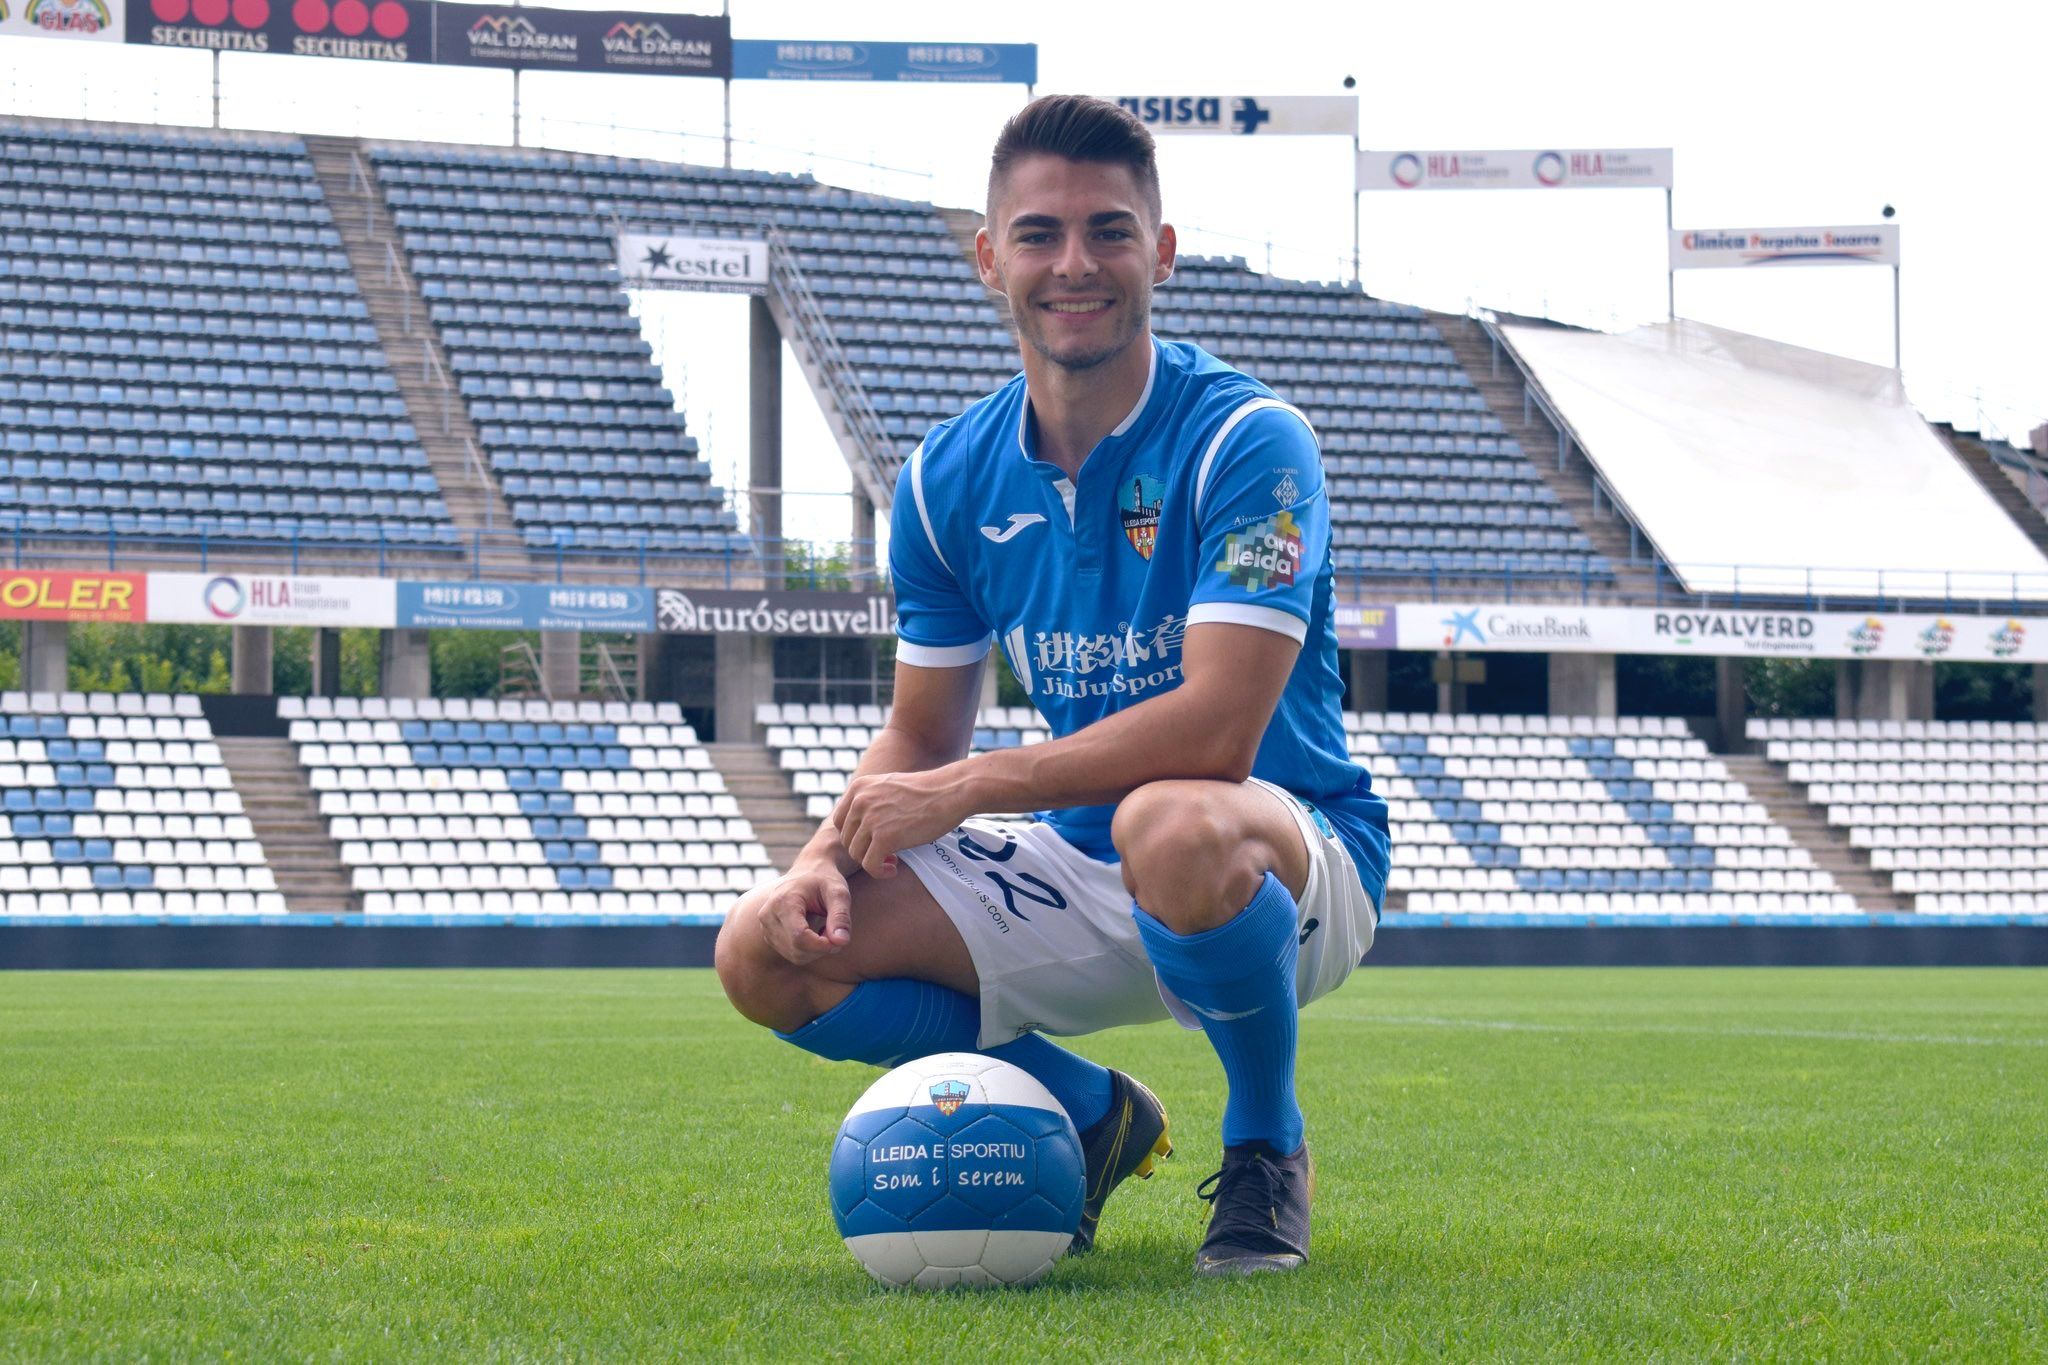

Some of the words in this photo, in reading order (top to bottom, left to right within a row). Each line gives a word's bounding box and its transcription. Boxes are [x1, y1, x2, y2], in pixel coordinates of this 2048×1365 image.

[151, 25, 269, 52] SECURITAS
[293, 35, 408, 61] SECURITAS
[467, 30, 504, 46] VAL
[602, 37, 639, 53] VAL
[1428, 155, 1460, 177] HLA
[1571, 154, 1604, 176] HLA
[675, 254, 751, 278] estel
[1264, 533, 1299, 558] ara
[1227, 543, 1292, 575] lleida
[0, 577, 134, 610] OLER
[251, 581, 291, 609] HLA
[1488, 615, 1590, 638] CaixaBank
[1655, 614, 1813, 638] ROYALVERD
[872, 1145, 928, 1163] LLEIDA
[958, 1169, 1025, 1186] serem
